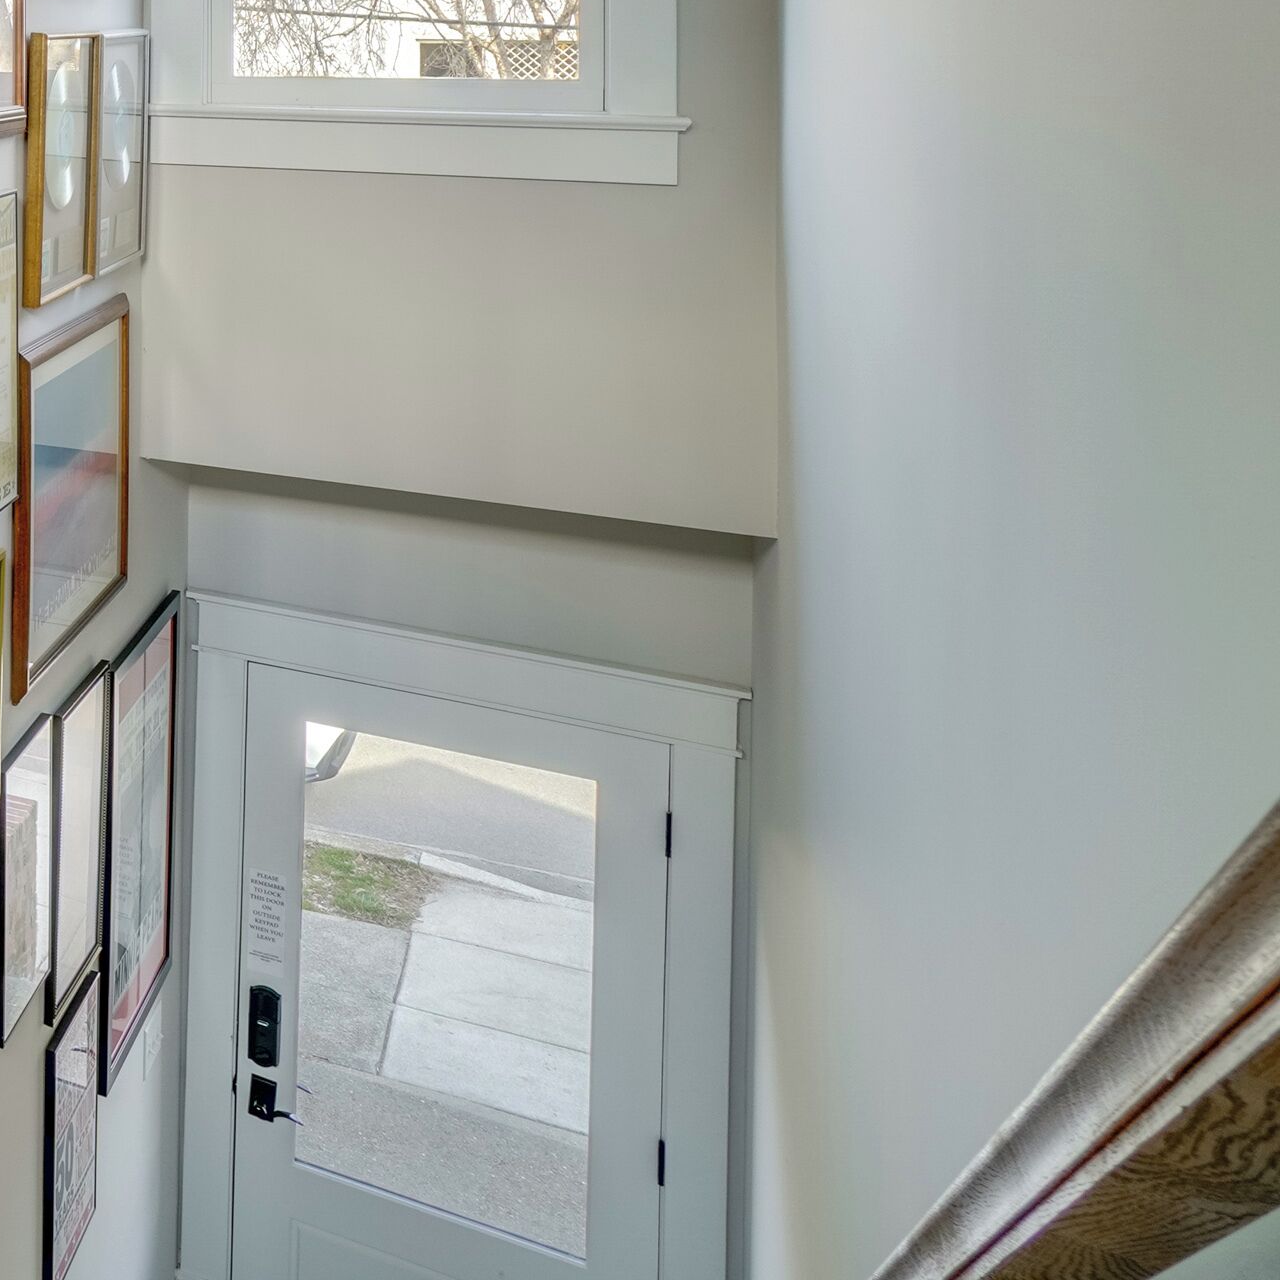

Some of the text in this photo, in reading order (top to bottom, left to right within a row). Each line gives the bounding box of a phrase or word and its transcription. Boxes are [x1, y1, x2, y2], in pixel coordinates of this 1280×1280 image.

[257, 872, 278, 881] PLEASE
[251, 879, 285, 891] REMEMBER
[264, 889, 281, 898] LOCK
[266, 898, 284, 906] DOOR
[253, 910, 280, 921] OUTSIDE
[255, 918, 279, 928] KEYPAD
[249, 924, 269, 933] WHEN
[257, 933, 275, 942] LEAVE
